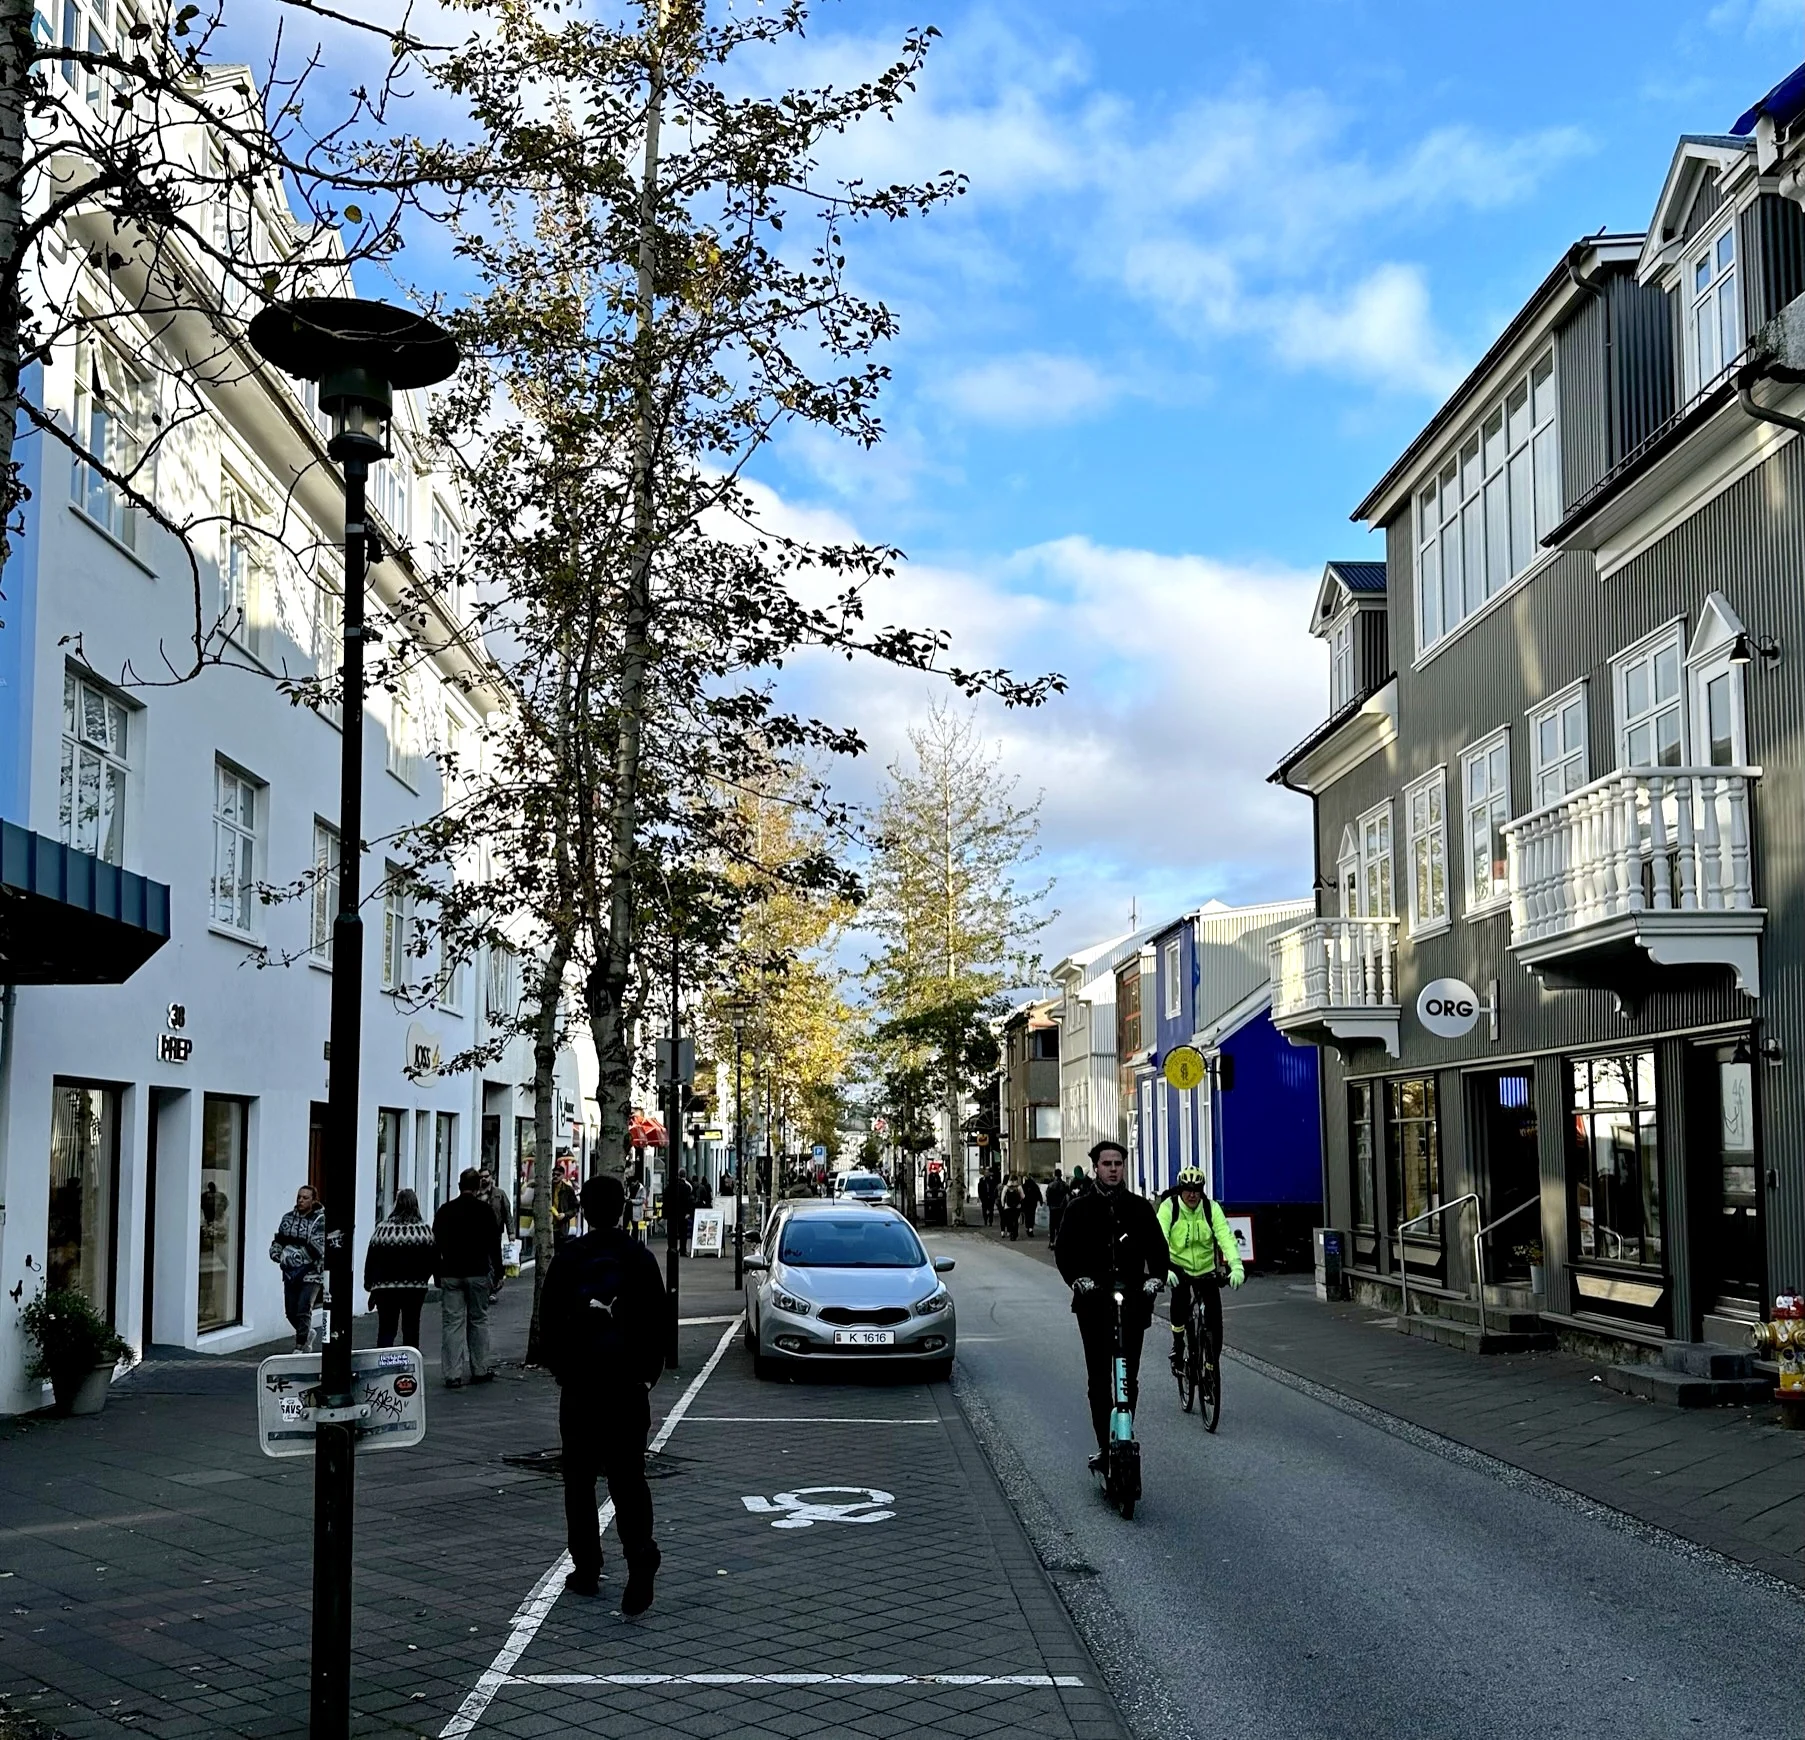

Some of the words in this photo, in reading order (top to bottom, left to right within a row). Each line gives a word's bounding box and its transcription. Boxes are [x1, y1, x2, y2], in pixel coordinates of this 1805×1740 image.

[1426, 999, 1473, 1017] ORG
[159, 1034, 192, 1061] PREP
[849, 1333, 857, 1342] K
[863, 1333, 886, 1342] 1616
